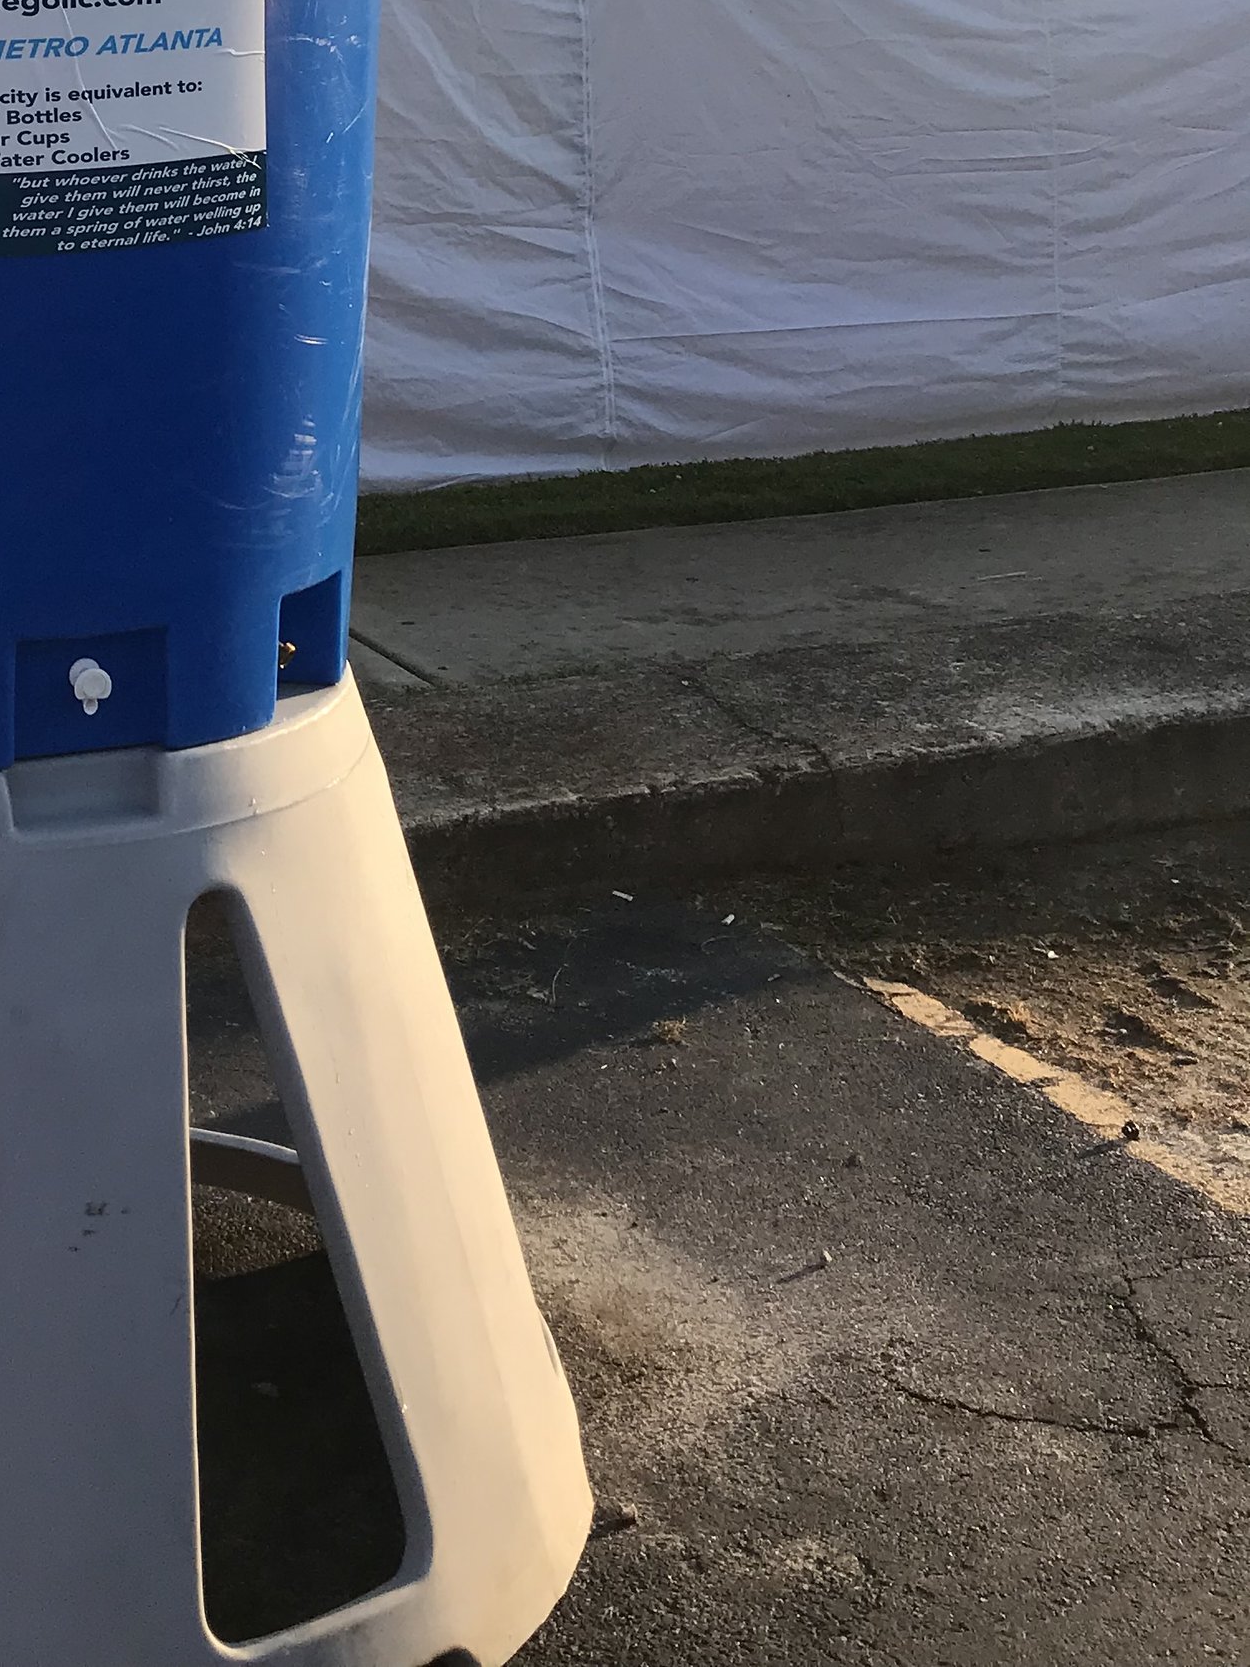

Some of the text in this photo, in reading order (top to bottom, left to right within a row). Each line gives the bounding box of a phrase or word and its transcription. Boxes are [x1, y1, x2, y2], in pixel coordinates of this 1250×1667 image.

[95, 27, 223, 56] ATLANTA
[45, 86, 61, 103] is
[68, 81, 172, 105] equivalent
[177, 80, 203, 93] to:
[6, 107, 82, 125] Bottles
[16, 130, 70, 150] Cups
[50, 147, 130, 165] Coolers
[55, 173, 128, 187] whoever
[131, 166, 179, 181] drinks
[183, 162, 206, 176] the
[211, 158, 247, 172] water
[12, 209, 64, 222] water
[76, 205, 114, 221] give
[118, 201, 159, 214] them
[164, 195, 190, 209] will
[192, 190, 246, 206] become
[249, 186, 261, 197] in
[20, 171, 257, 208] give them will never thirst, the
[2, 203, 262, 238] them a spring of water welling up
[57, 240, 76, 251] to
[80, 233, 140, 249] eternal
[196, 222, 230, 237] John
[233, 215, 262, 230] 4:14
